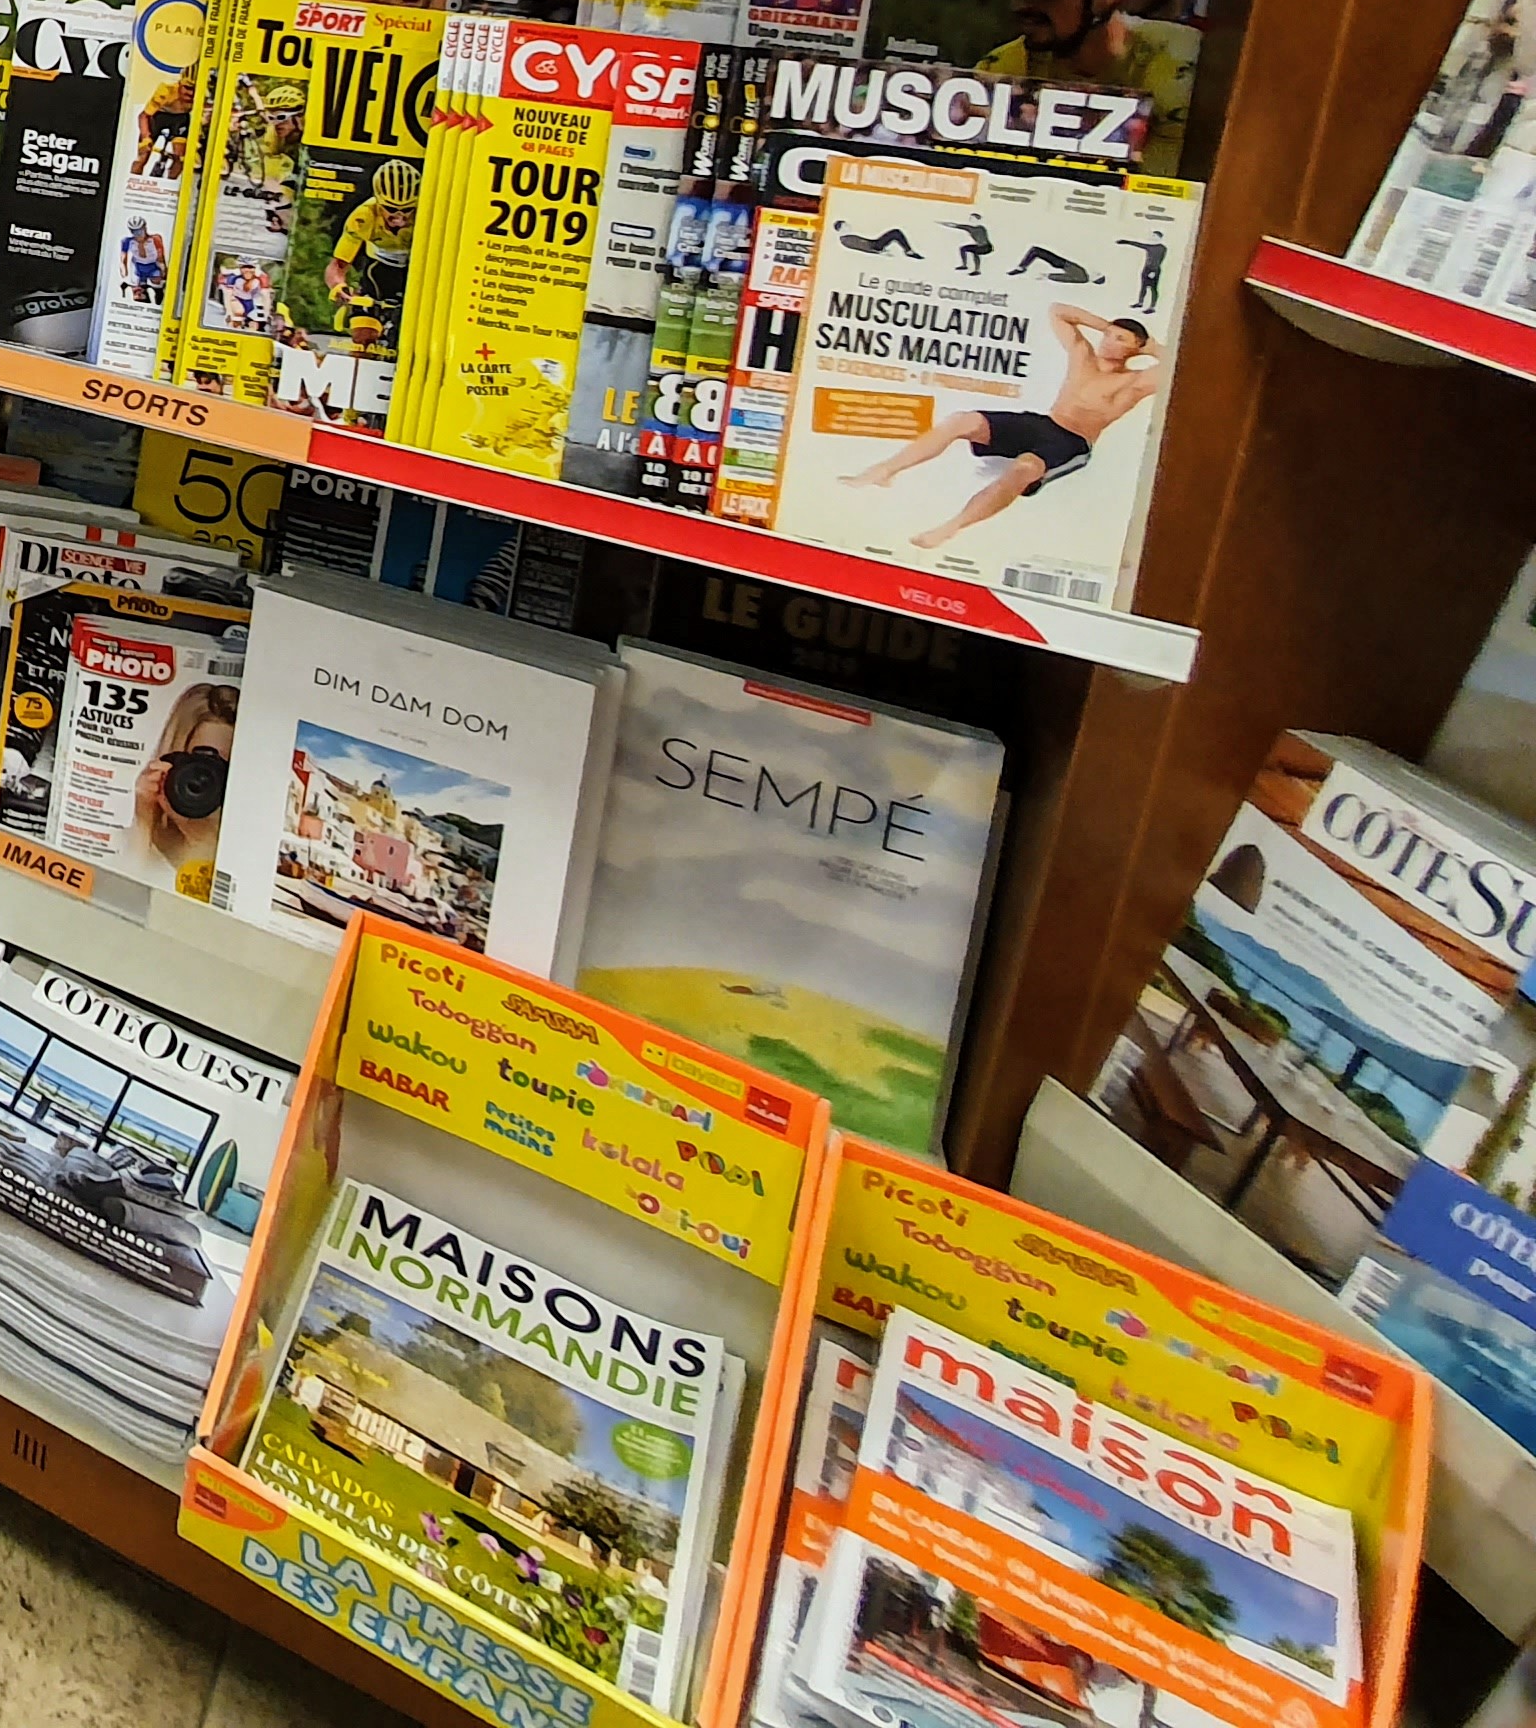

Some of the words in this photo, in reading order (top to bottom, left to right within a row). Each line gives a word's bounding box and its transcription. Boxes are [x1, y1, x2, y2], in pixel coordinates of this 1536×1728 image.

[296, 5, 366, 34] SPORT
[371, 11, 433, 33] Spécial
[511, 106, 593, 131] NOUVEAU
[769, 55, 1140, 161] MUSCLEZ
[20, 144, 100, 176] Sagan
[22, 128, 78, 153] Peter
[511, 124, 564, 146] GUIDE
[569, 124, 588, 146] DE
[488, 156, 601, 207] TOUR
[9, 224, 52, 243] Iseran
[484, 200, 589, 246] 2019
[858, 272, 882, 290] Le
[885, 276, 935, 300] guide
[938, 281, 1009, 308] complet
[827, 290, 1031, 345] MUSCULATION
[460, 363, 475, 375] LA
[476, 363, 512, 376] CARTE
[815, 323, 891, 360] SANS
[898, 336, 1032, 378] MACHINE
[82, 380, 209, 426] SPORTS
[466, 384, 510, 397] POSTER
[898, 585, 967, 617] VELOS
[85, 649, 172, 682] PHOTO
[79, 706, 134, 729] ASTUCES
[82, 679, 150, 715] 135
[310, 665, 364, 700] DIM
[369, 684, 436, 722] DAM
[439, 704, 512, 745] DOM
[653, 734, 934, 865] SEMPÉ
[2, 839, 86, 892] IMAGE
[379, 942, 467, 994] Picoti
[406, 987, 538, 1055] Toboggan
[500, 992, 600, 1046] SAMSAM
[365, 1017, 468, 1075] wakou
[358, 1057, 451, 1113] BABAR
[497, 1057, 597, 1118] toupie
[482, 1117, 555, 1158] mains
[483, 1099, 557, 1143] Petites
[676, 1138, 766, 1198] POPI
[860, 1167, 971, 1231] Picoti
[111, 1227, 166, 1259] LIBRES
[893, 1216, 1058, 1300] Toboggan
[357, 1192, 710, 1380] MAISONS
[842, 1244, 969, 1315] wakou
[343, 1230, 700, 1419] NORMANDIE
[1005, 1295, 1129, 1370] toupie
[901, 1331, 1297, 1560] maison
[260, 1431, 396, 1518] CALVADOS
[241, 1535, 341, 1621] DES
[298, 1531, 379, 1598] LA
[389, 1581, 595, 1727] PRESSE
